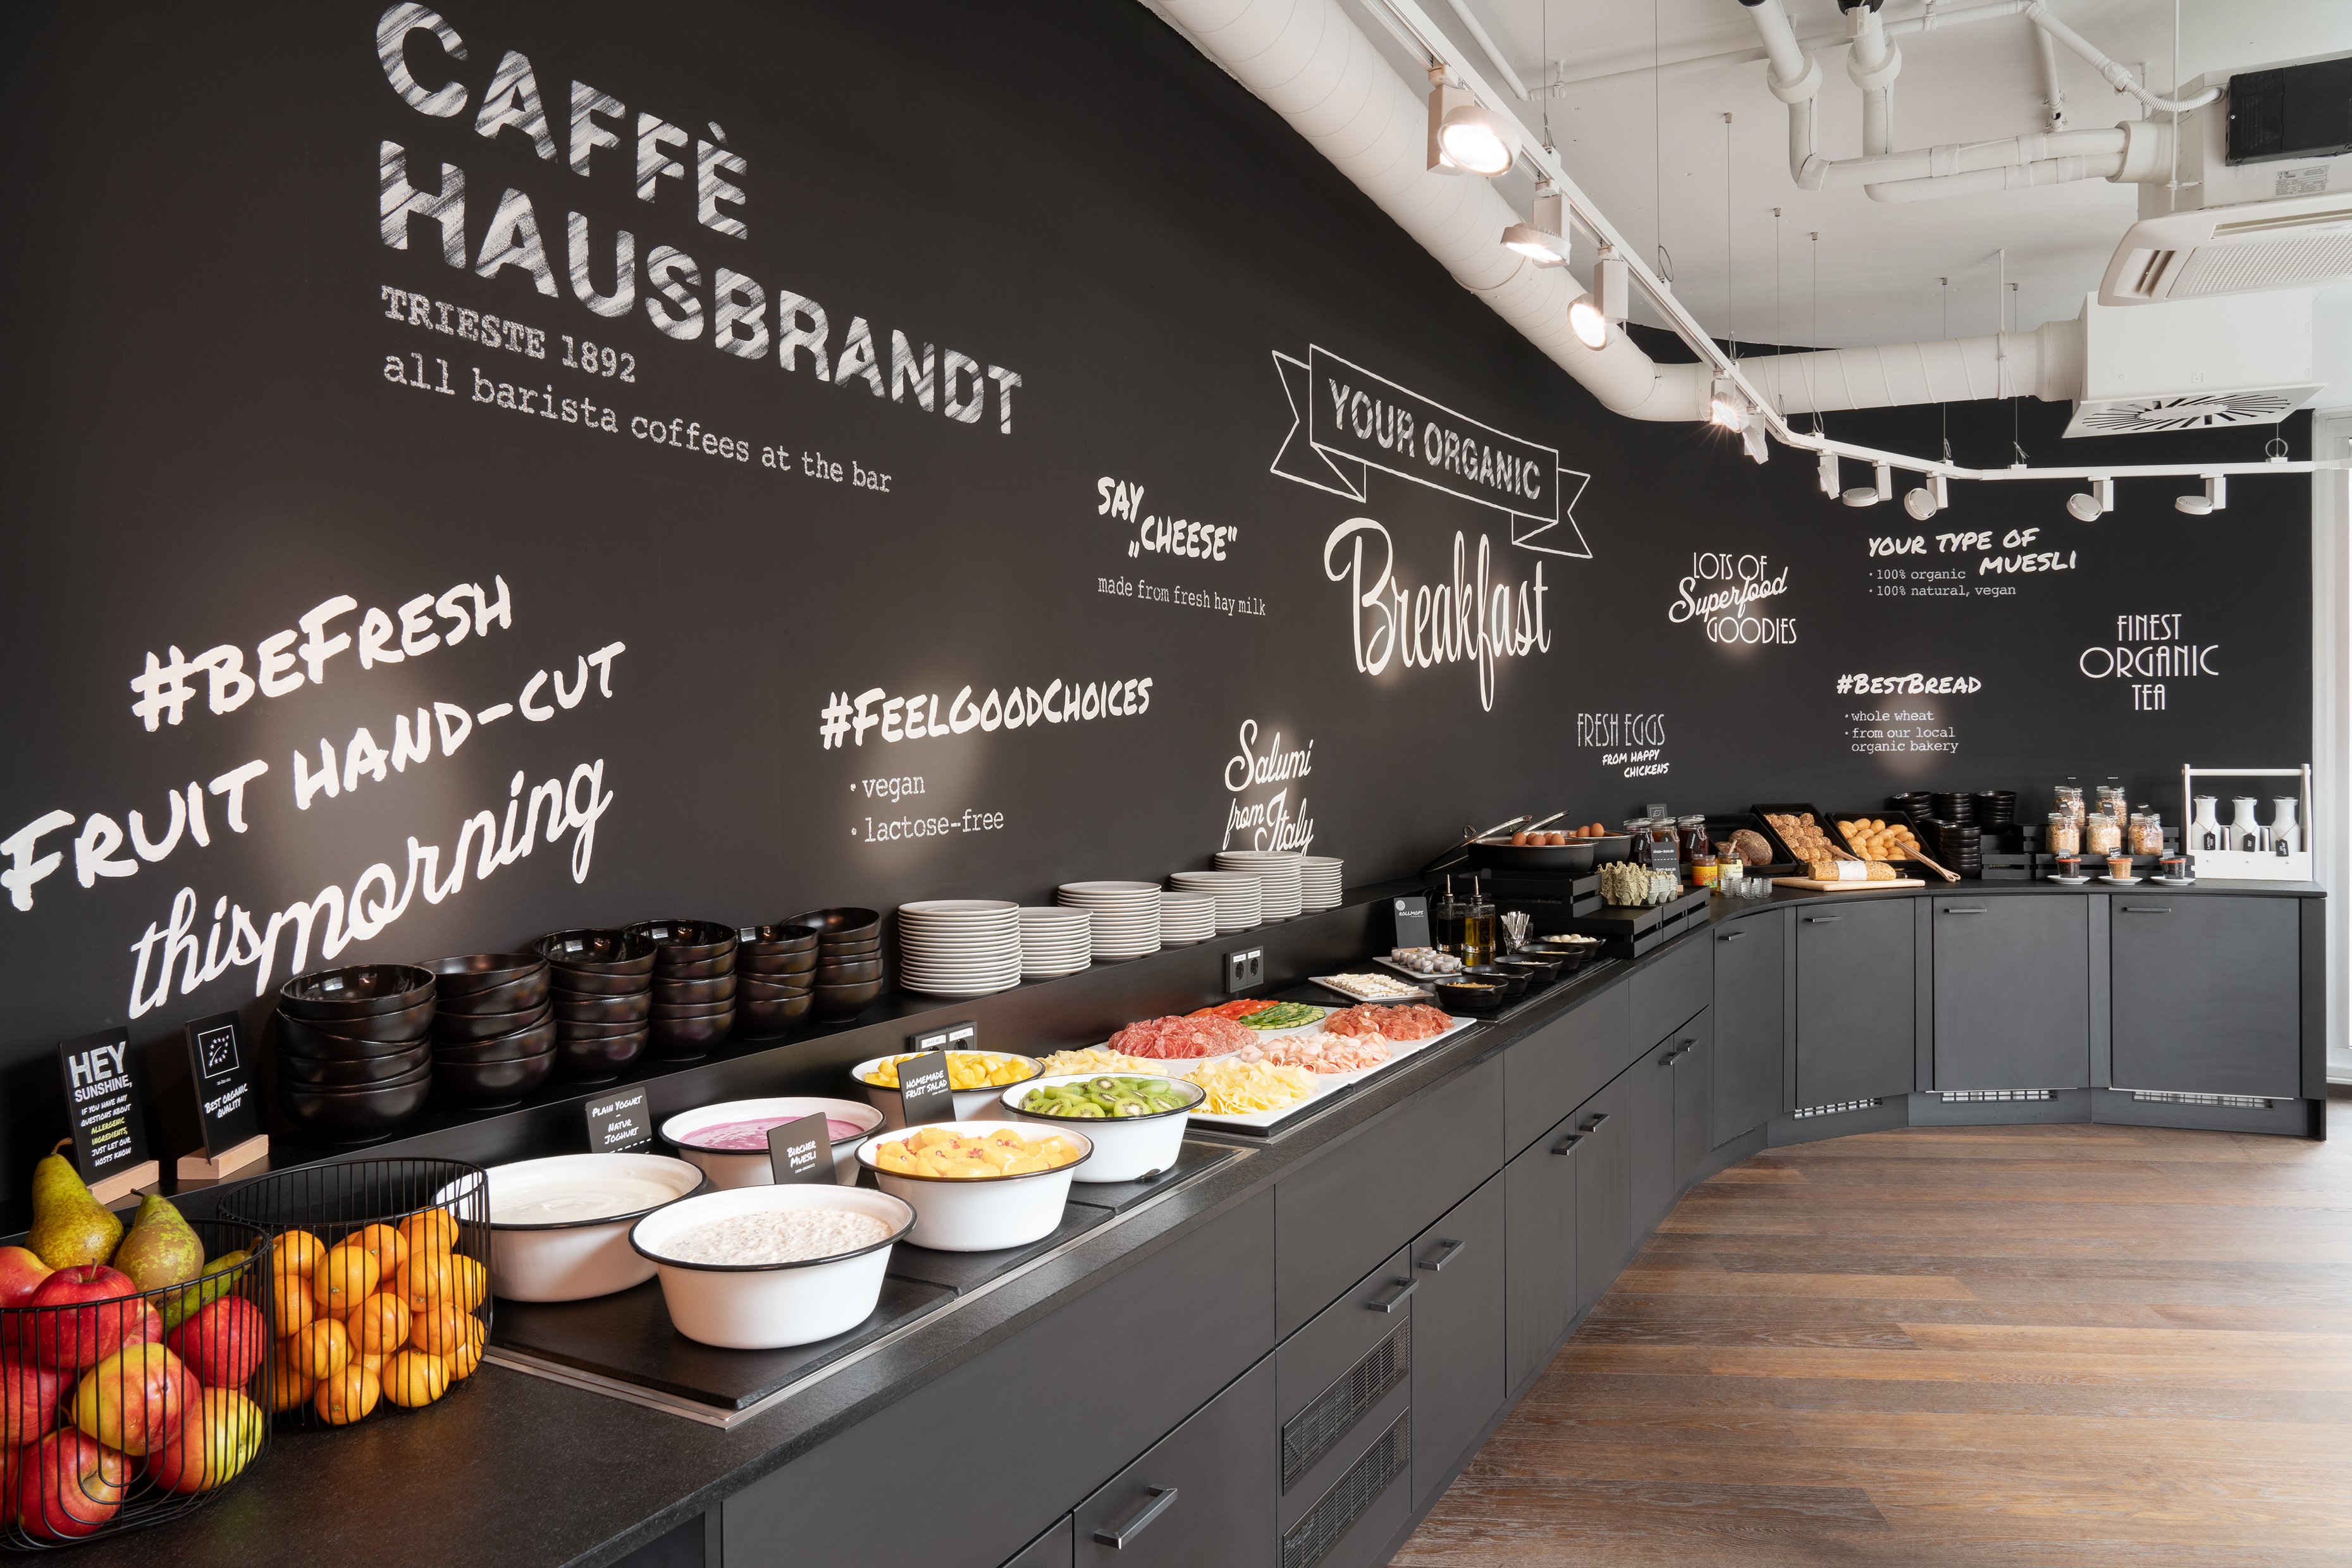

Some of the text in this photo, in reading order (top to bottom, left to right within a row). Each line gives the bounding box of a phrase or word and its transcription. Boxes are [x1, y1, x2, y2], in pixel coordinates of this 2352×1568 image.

[377, 3, 746, 240] CAFFÈ
[380, 140, 1021, 434] HAUSBRANDT
[382, 286, 635, 383] TRIESTE 1892
[384, 353, 891, 492] all barista coffees at the bar
[1329, 379, 1541, 499] YOUR ORGANIC
[1098, 477, 1144, 523] SAY
[1869, 528, 2040, 557] YOUR TYPE OF
[1694, 552, 1767, 581] LOTS OF
[1878, 569, 1965, 582] 100% organic
[1979, 551, 2076, 575] MUESLI
[1099, 577, 1265, 616] made from fresh hay milk
[1668, 567, 1789, 623] Superfood
[1878, 585, 2016, 597] 100% natural, vegan
[1324, 518, 1551, 712] Breakfast
[2117, 614, 2181, 640] FINEST
[1706, 616, 1797, 644] GOODIES
[2080, 645, 2218, 678] ORGANIC
[2132, 684, 2165, 710] TEA
[1851, 711, 1934, 721] whole wheat
[1577, 714, 1665, 746] FRESH EGGS
[1853, 728, 1883, 738] from
[1916, 727, 1955, 737] local
[1225, 720, 1313, 791] Salumi
[1602, 749, 1660, 766] FROM HAPPY
[1852, 740, 1958, 754] organic bakery
[0, 641, 625, 911] FRUIT HAND-CUT
[1623, 763, 1670, 778] CHICKENS
[862, 774, 925, 802] vegan
[865, 809, 1003, 842] lactose-free
[1222, 787, 1314, 857] from Italy
[68, 1041, 126, 1088] HEY
[74, 1074, 133, 1103] SUNSHINE,
[906, 1070, 944, 1089] HOMEMADE
[906, 1079, 947, 1099] FRUIT SALAD
[81, 1094, 127, 1116] IF YOU HAVE ANY
[204, 1083, 248, 1114] BEST ORGANIC
[217, 1098, 241, 1118] QUALITY
[592, 1095, 643, 1117] PLAIN YOGURT
[80, 1103, 132, 1127] QUESTIONS ABOUT
[91, 1117, 125, 1135] ALLERGENIC
[608, 1118, 632, 1132] NATUR
[91, 1127, 128, 1146] INGREDIENTS,
[91, 1136, 132, 1157] JUST LET OUR
[604, 1127, 639, 1145] JOGHURT
[787, 1140, 816, 1158] BIRCHER
[94, 1146, 132, 1167] HOSTS KNOW
[790, 1150, 816, 1168] MUESLI
